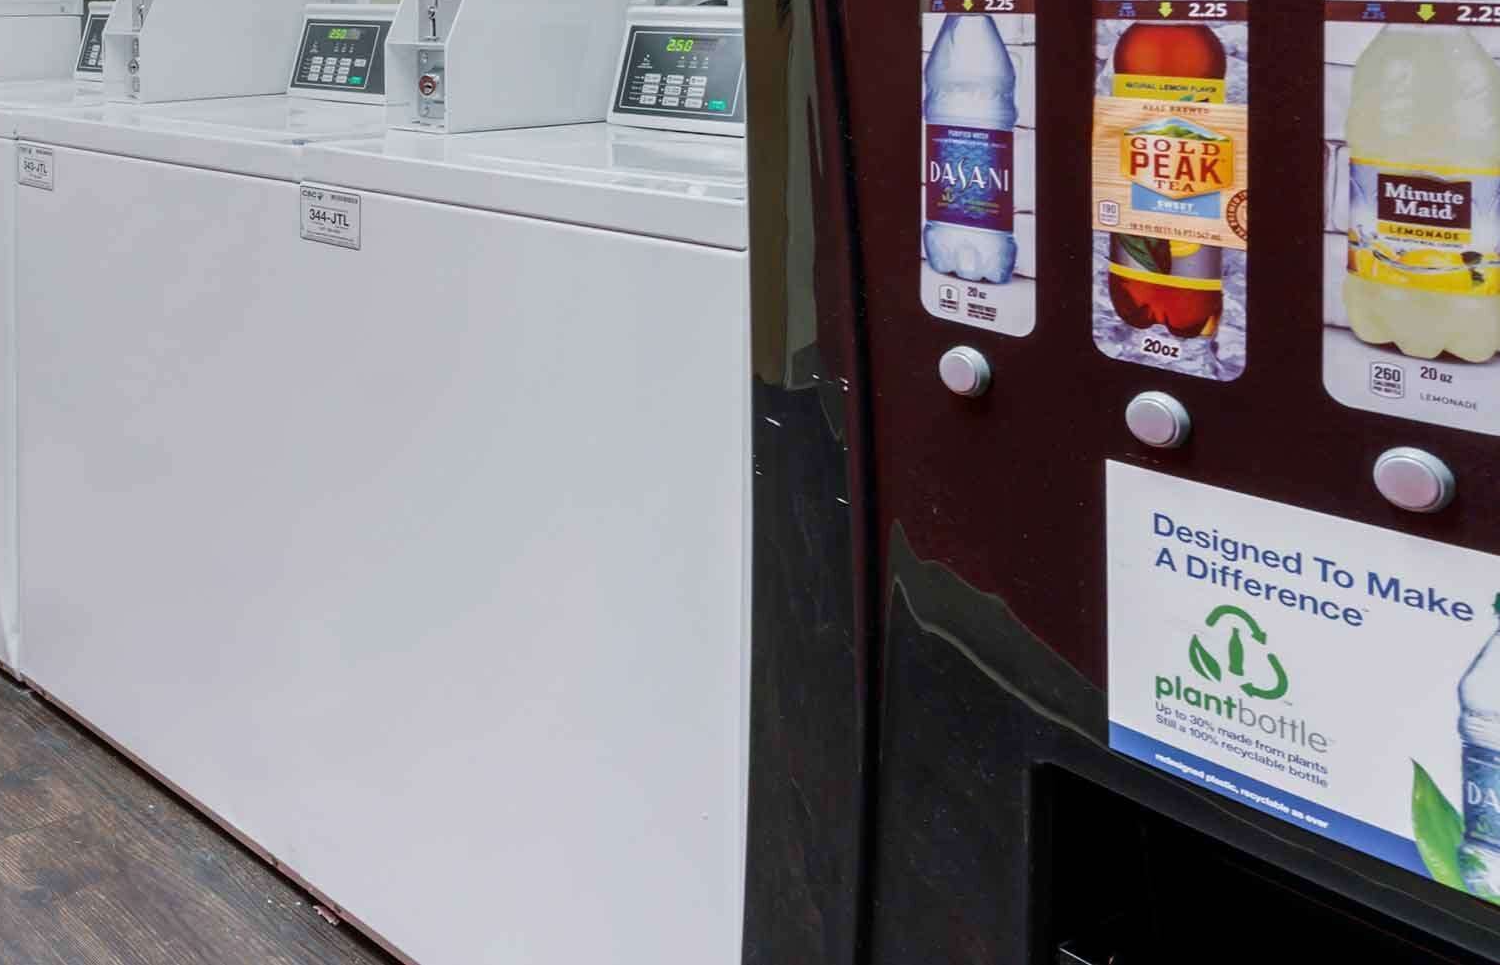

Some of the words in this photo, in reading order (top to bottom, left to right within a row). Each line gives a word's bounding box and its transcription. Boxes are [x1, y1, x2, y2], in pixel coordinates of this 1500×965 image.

[1187, 2, 1228, 18] 2.25
[666, 39, 694, 52] 250
[1159, 83, 1189, 91] LEMON
[1130, 136, 1221, 157] GOLD
[930, 155, 1009, 193] DASANI
[1129, 150, 1223, 185] PEAK
[1153, 179, 1196, 193] TEA
[1385, 181, 1465, 205] Minute
[308, 207, 350, 227] 344-JTL
[1394, 198, 1453, 221] Maid
[1389, 224, 1461, 241] LEMONADE
[1143, 337, 1180, 358] 20oz
[1373, 365, 1401, 382] 260
[1420, 366, 1438, 381] 20
[1440, 373, 1453, 384] oz
[1420, 392, 1478, 410] LEMONADE
[1153, 512, 1302, 575] Designed
[1314, 556, 1355, 590] To
[1367, 571, 1475, 623] Make
[1155, 547, 1177, 573] A
[1187, 554, 1364, 627] Difference
[1155, 674, 1329, 755] plantbottle
[1156, 700, 1172, 716] Up
[1175, 709, 1187, 721] to
[1189, 714, 1215, 733] 30%
[1218, 726, 1253, 747] made
[1255, 739, 1286, 759] from
[1288, 753, 1329, 775] plants
[1156, 713, 1177, 730] Still
[1190, 726, 1219, 746] 100%
[1221, 740, 1285, 772] recyclable
[1288, 765, 1329, 789] bottle
